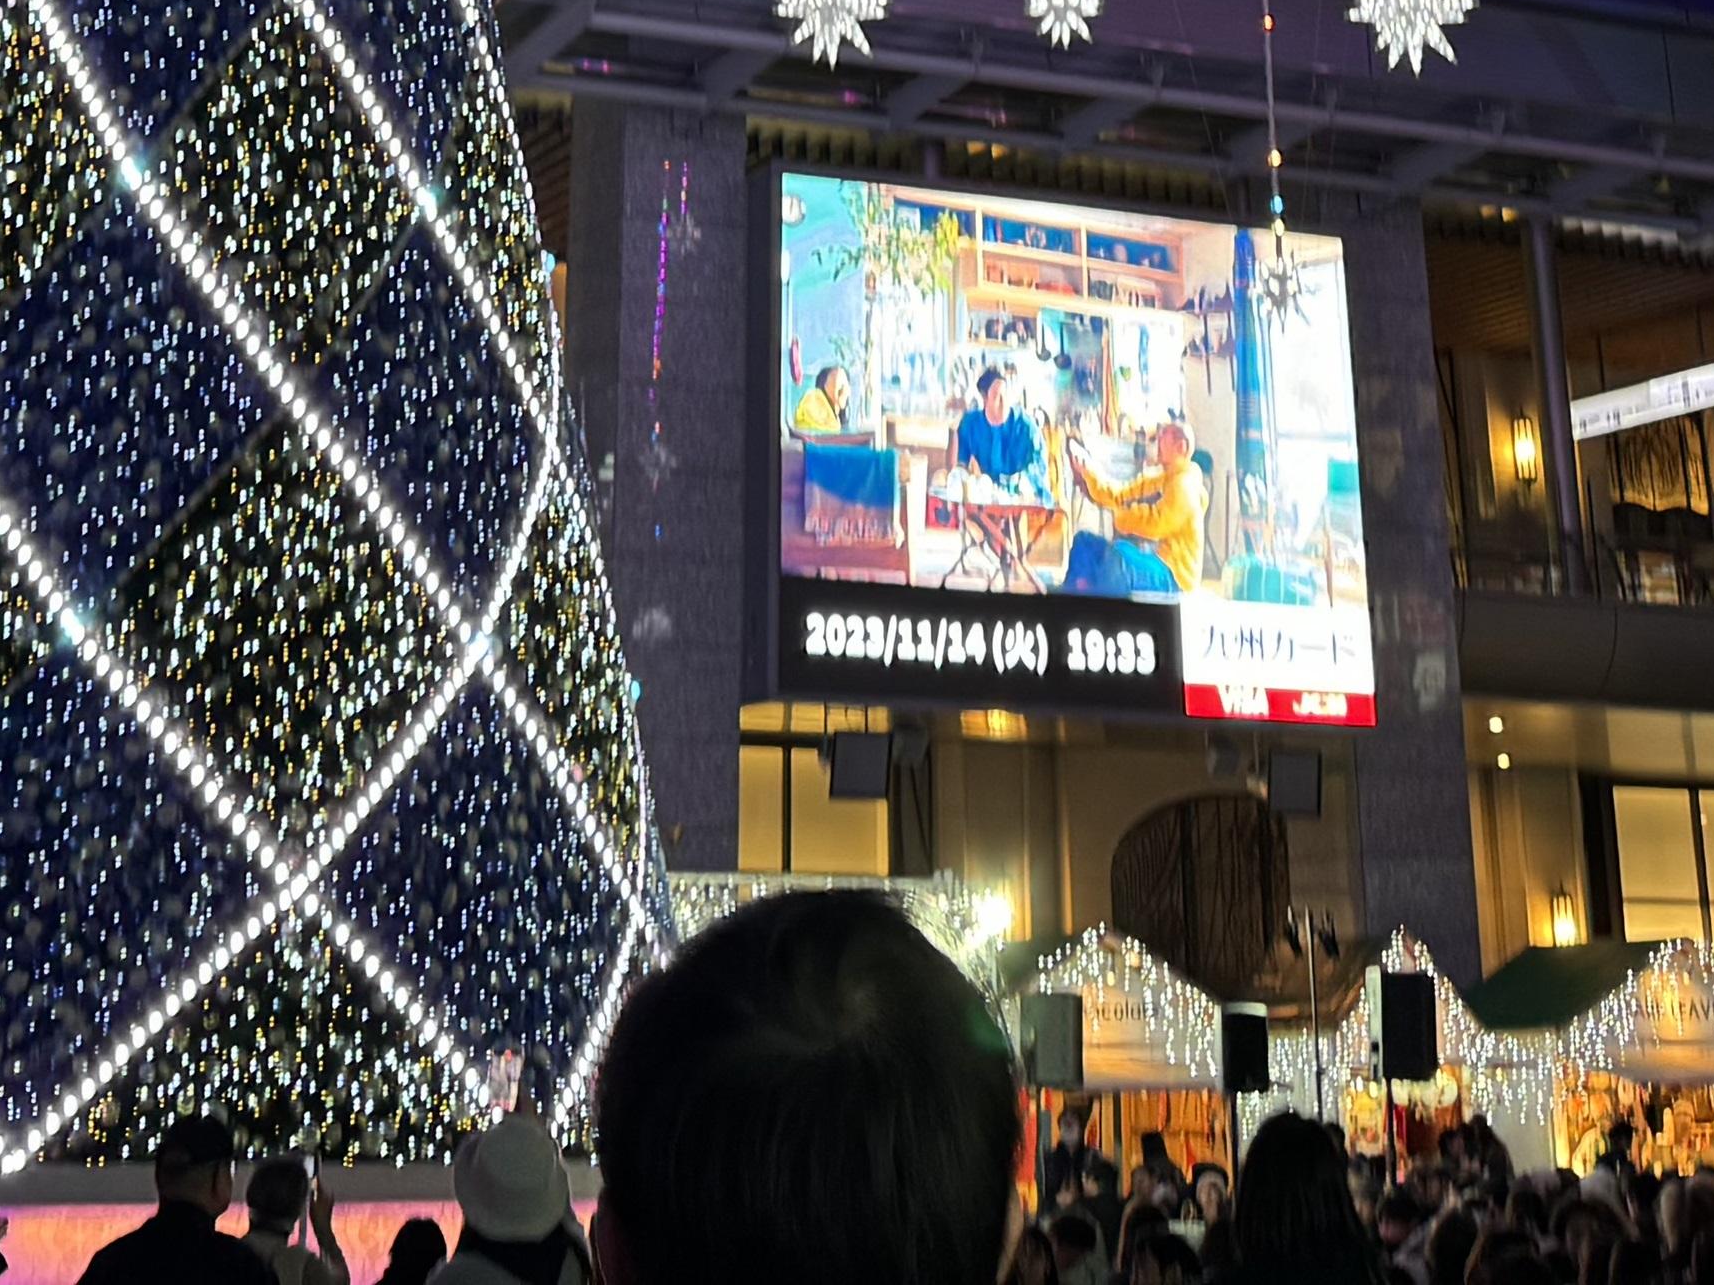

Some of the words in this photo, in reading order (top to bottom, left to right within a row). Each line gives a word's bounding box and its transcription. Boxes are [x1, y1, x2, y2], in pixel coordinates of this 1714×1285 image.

[1203, 624, 1356, 667] 九州カード
